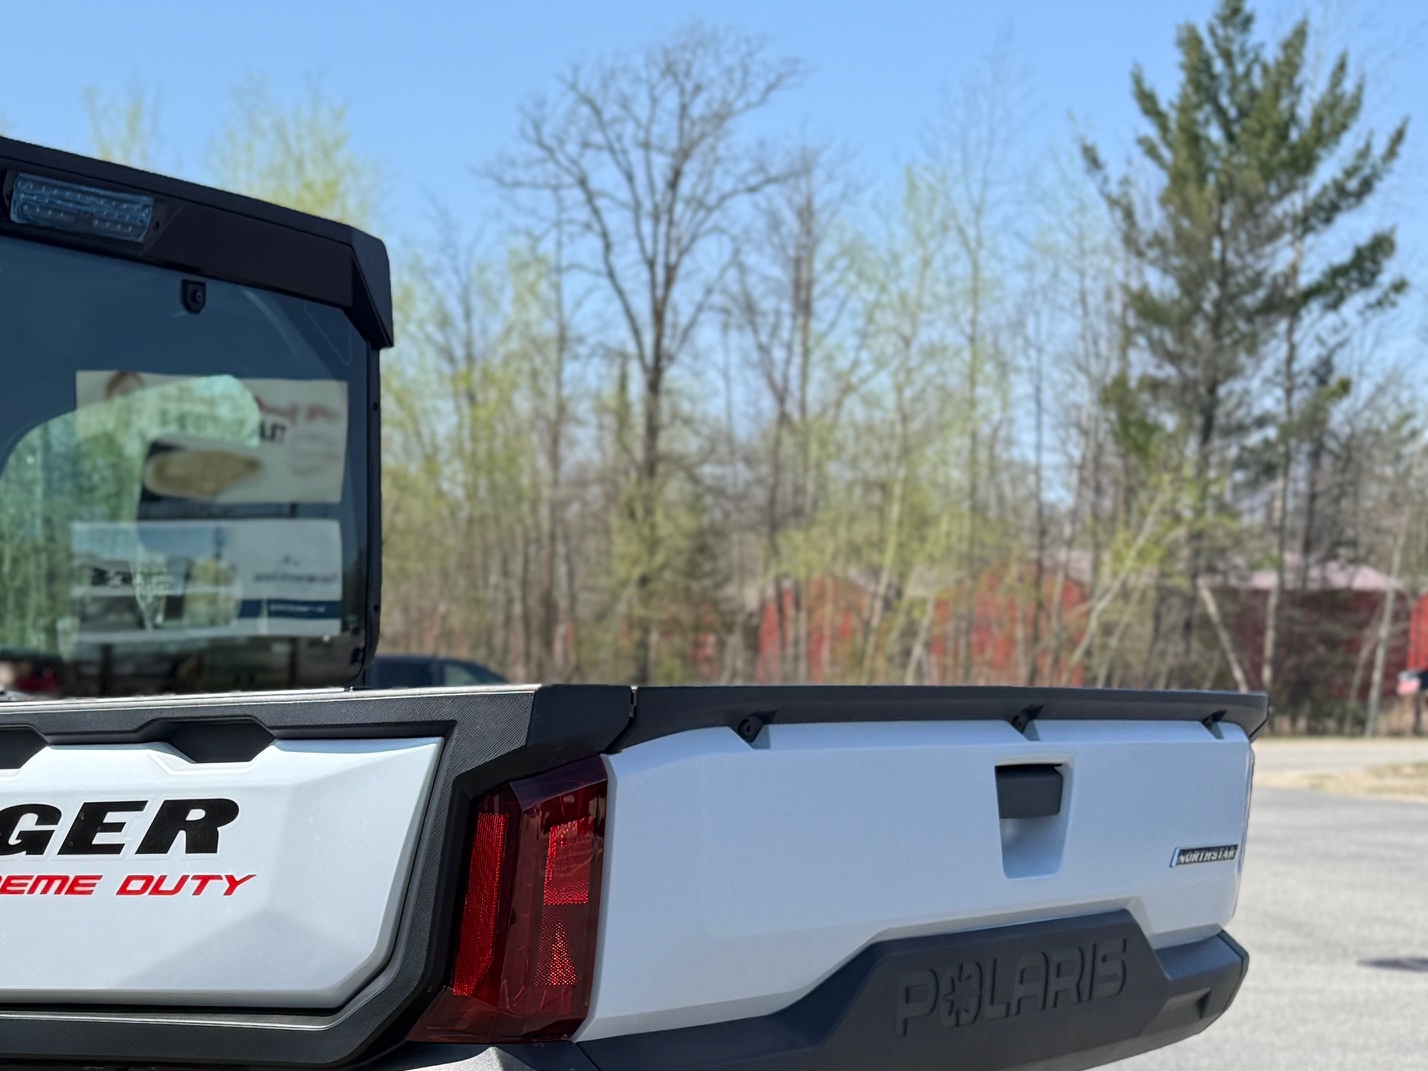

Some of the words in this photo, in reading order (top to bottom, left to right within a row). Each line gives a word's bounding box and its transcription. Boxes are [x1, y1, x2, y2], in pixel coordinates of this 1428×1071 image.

[1178, 846, 1236, 864] NORTHSTAR
[115, 874, 257, 896] DUTY
[896, 938, 1127, 1038] POLARIS
